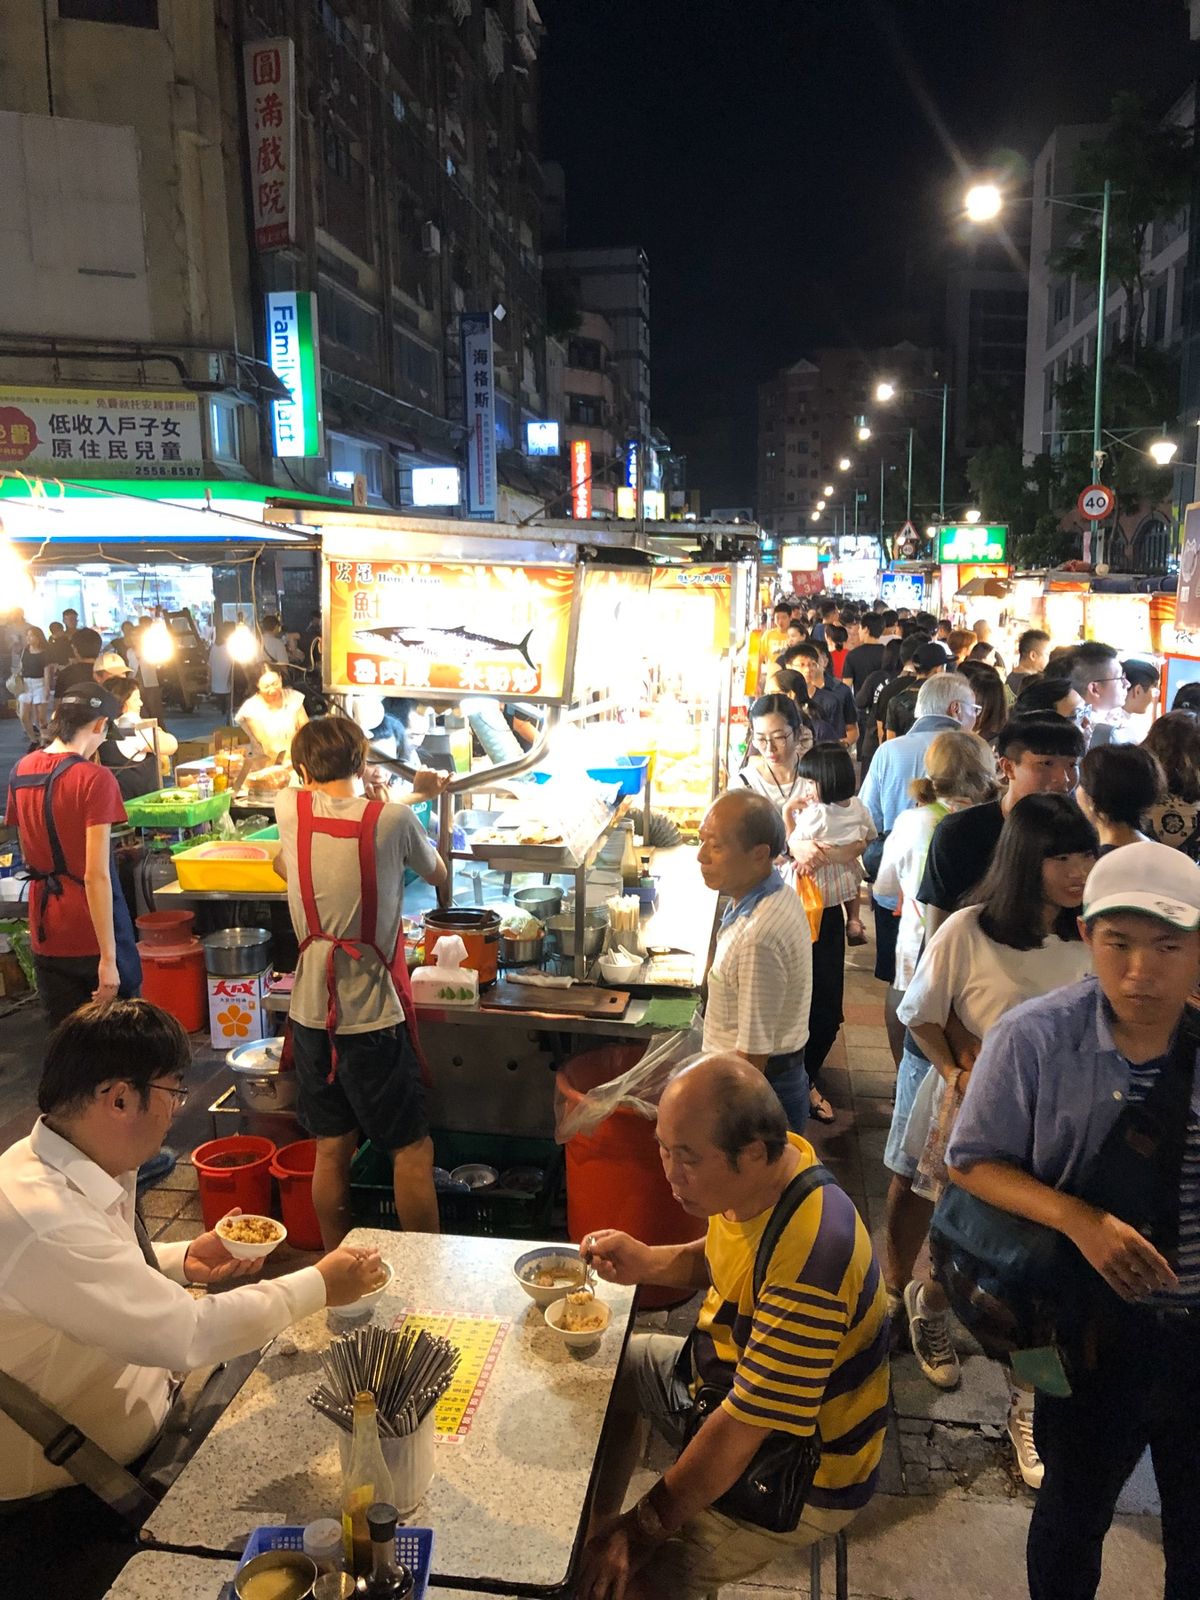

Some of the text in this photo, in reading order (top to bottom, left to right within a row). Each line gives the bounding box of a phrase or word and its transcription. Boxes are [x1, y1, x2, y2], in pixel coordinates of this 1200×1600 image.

[253, 49, 285, 218] 圓滿戲院
[272, 305, 297, 442] FamilyMart
[472, 349, 490, 409] 海格斯
[48, 413, 182, 437] 低收入戶子女
[52, 438, 182, 460] 原住民兒童
[1085, 497, 1106, 509] 40
[337, 563, 373, 583] 宏冠
